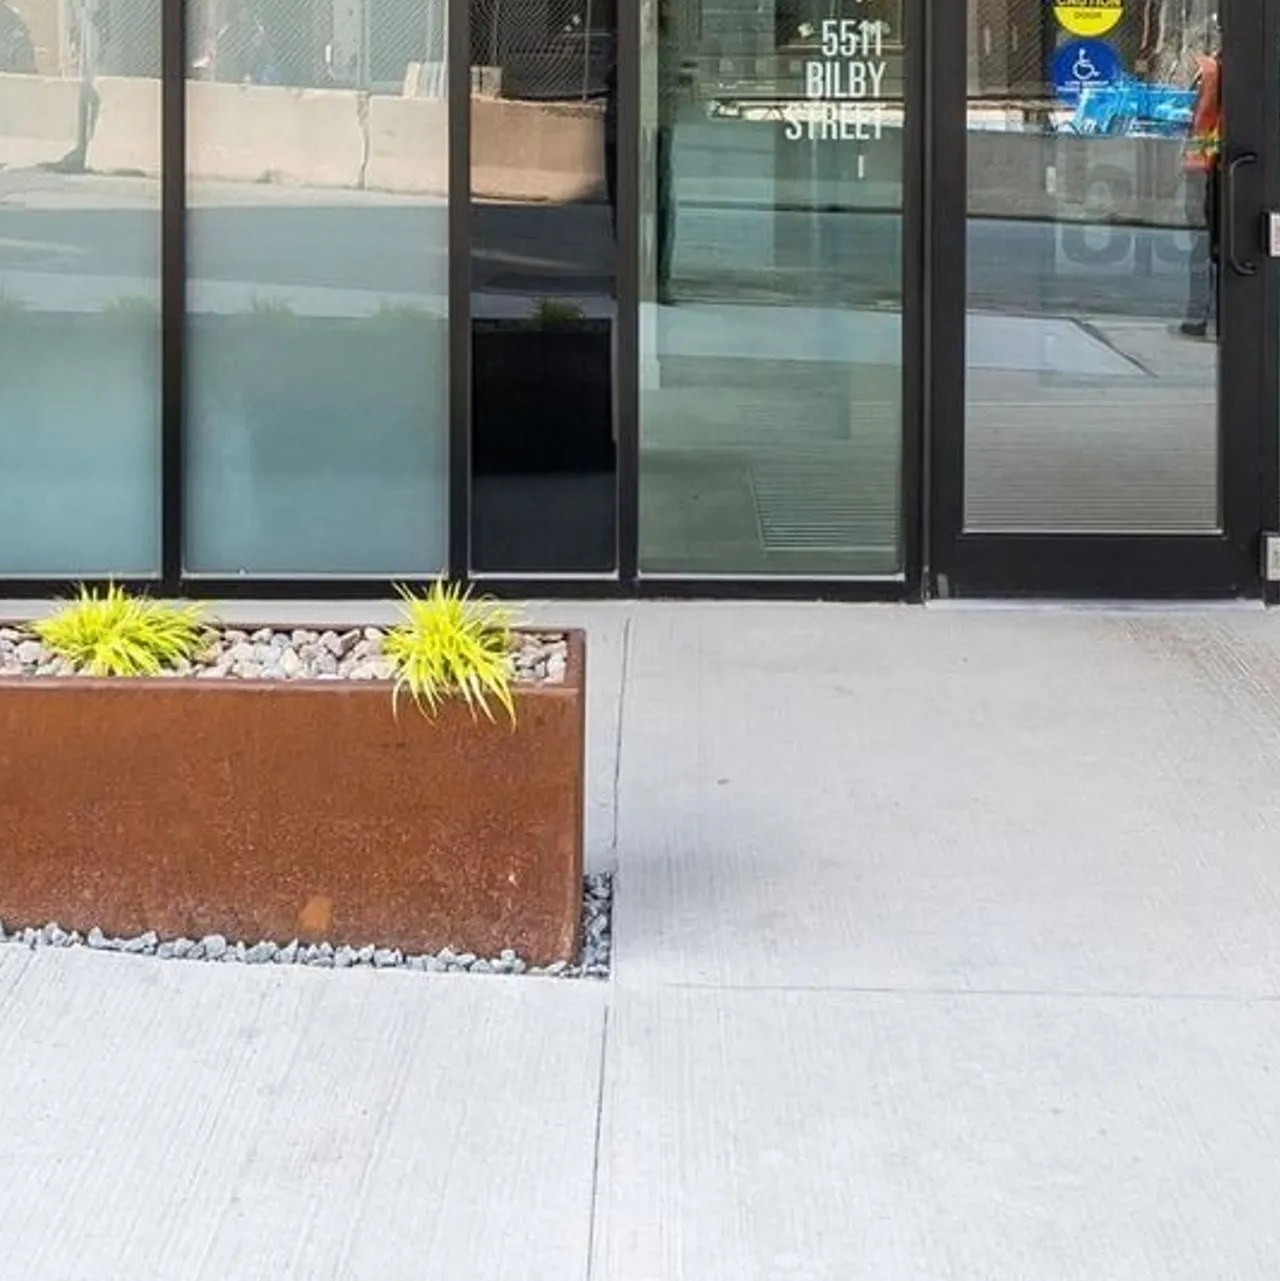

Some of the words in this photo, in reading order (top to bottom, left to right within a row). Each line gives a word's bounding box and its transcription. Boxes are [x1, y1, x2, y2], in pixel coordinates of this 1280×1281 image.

[822, 19, 884, 57] 5511
[806, 61, 888, 99] BILBY
[785, 103, 886, 140] STREET
